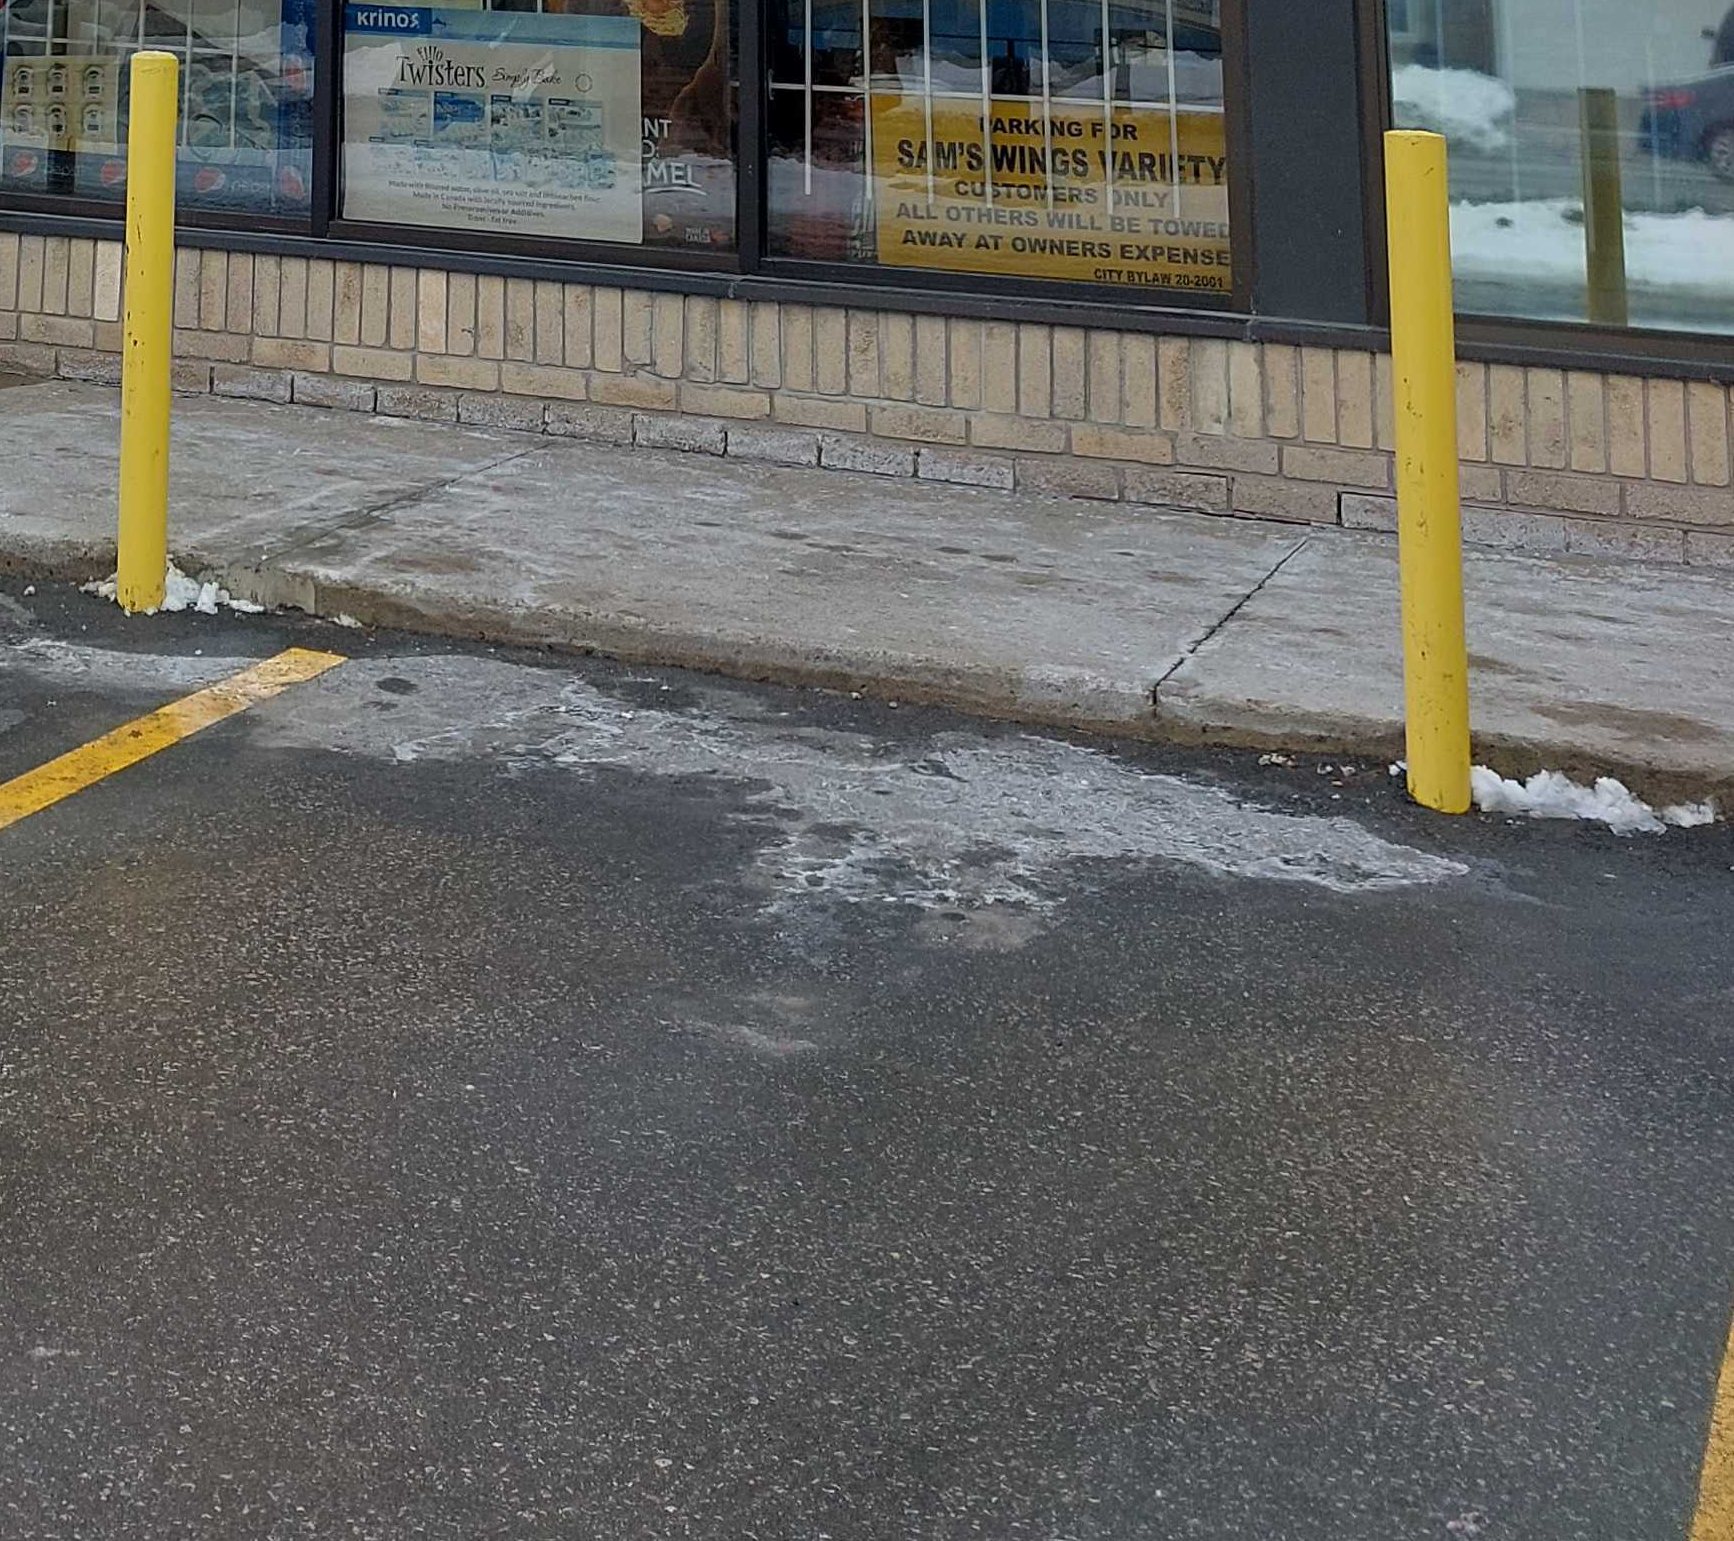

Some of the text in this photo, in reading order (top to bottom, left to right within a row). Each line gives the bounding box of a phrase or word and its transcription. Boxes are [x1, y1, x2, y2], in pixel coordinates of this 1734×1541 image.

[396, 55, 486, 88] Twisters
[1092, 122, 1138, 140] FOR
[897, 139, 1228, 186] SAM'S WINGS VARIETY
[954, 180, 1170, 208] CUSTOMERS ONLY
[896, 203, 938, 219] ALL
[946, 206, 1038, 227] OTHERS
[1046, 211, 1103, 231] WILL
[1111, 216, 1142, 234] BE
[902, 229, 1230, 266] AWAY AT OWNERS EXPENSE
[1094, 267, 1122, 282] CITY
[1126, 269, 1172, 285] BYLAW
